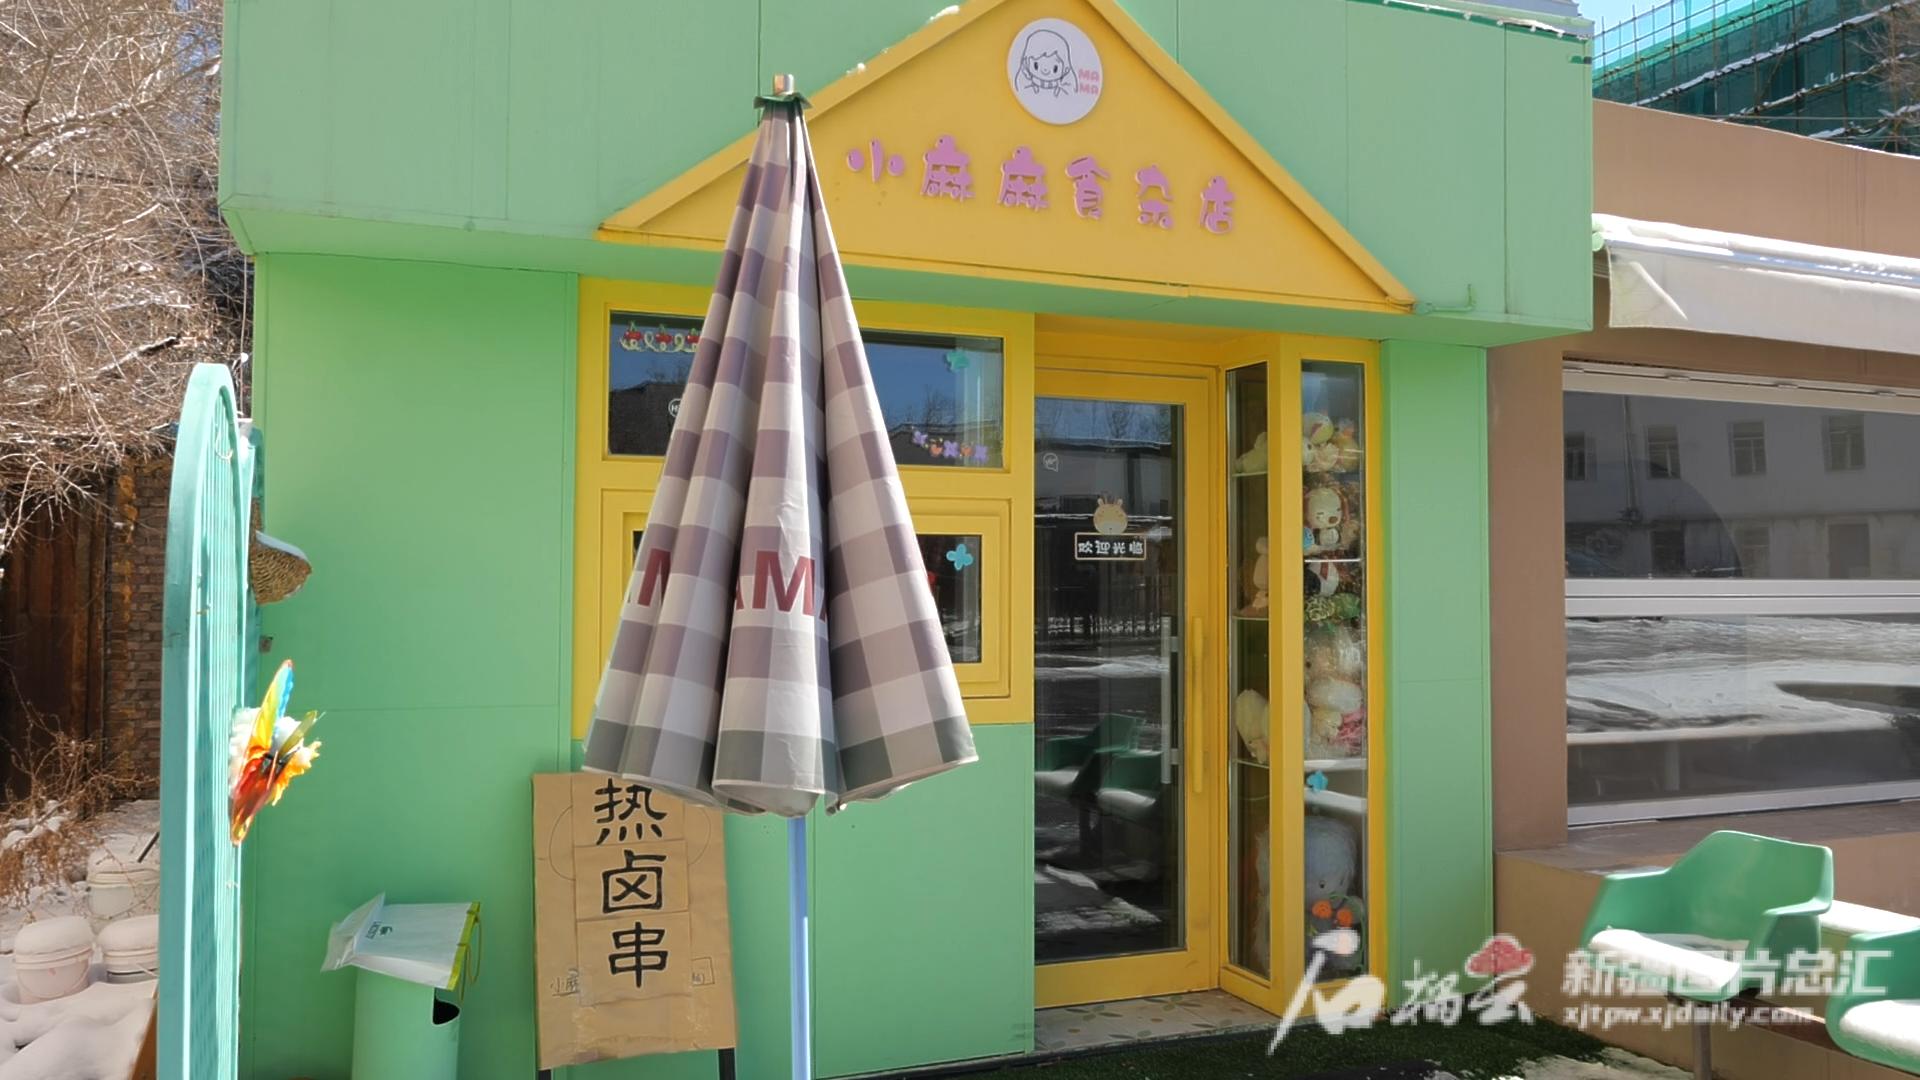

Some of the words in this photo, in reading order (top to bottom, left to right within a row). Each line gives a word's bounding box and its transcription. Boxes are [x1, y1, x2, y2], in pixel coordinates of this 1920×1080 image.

[846, 134, 1236, 234] 小麻麻食杂店
[1078, 540, 1144, 554] 欢迎光临
[594, 778, 668, 988] 热卤串
